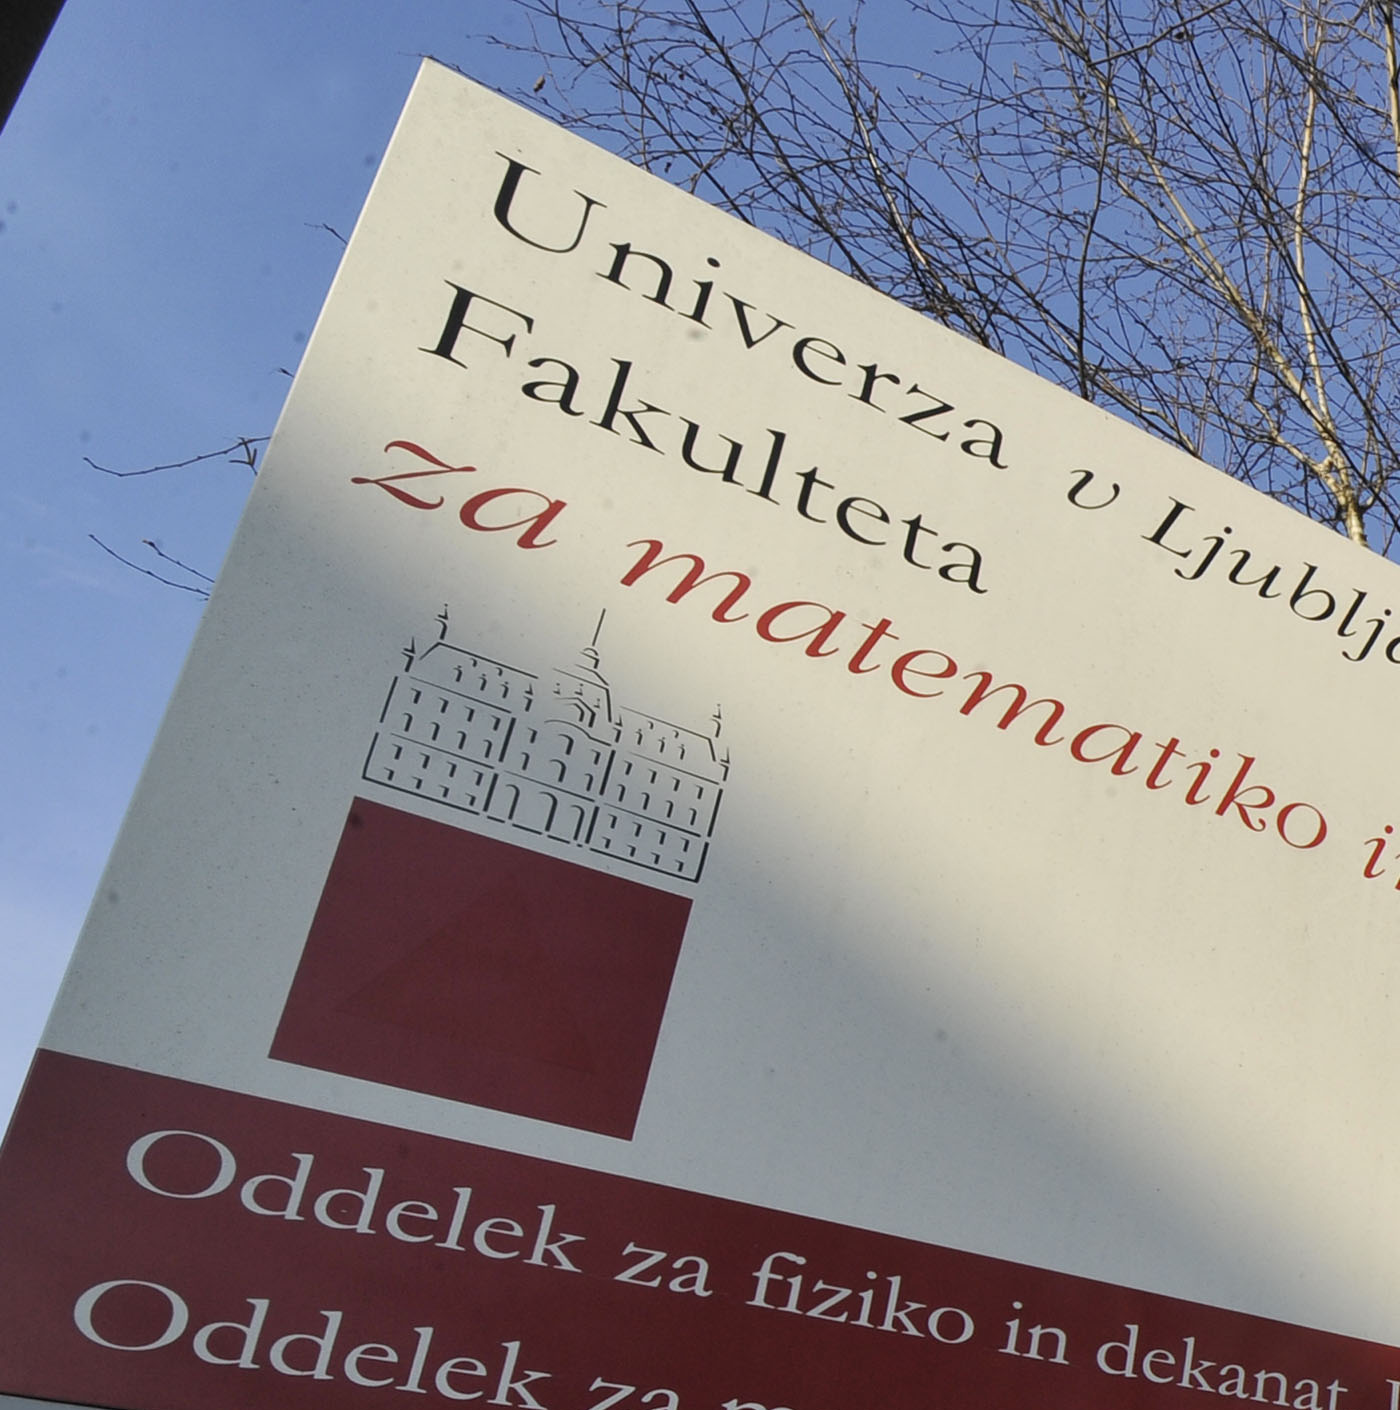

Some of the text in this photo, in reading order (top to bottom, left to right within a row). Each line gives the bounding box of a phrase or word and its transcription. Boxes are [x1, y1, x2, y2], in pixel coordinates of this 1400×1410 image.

[418, 279, 989, 595] Fakulteta
[493, 150, 1010, 470] Univerza
[1068, 470, 1120, 509] v
[351, 440, 567, 550] za
[620, 539, 1328, 849] matematiko
[73, 1279, 552, 1410] Oddelek
[126, 1130, 585, 1273] Oddelek
[613, 1240, 713, 1299] za
[744, 1248, 976, 1344] fiziko
[997, 1299, 1072, 1367] in
